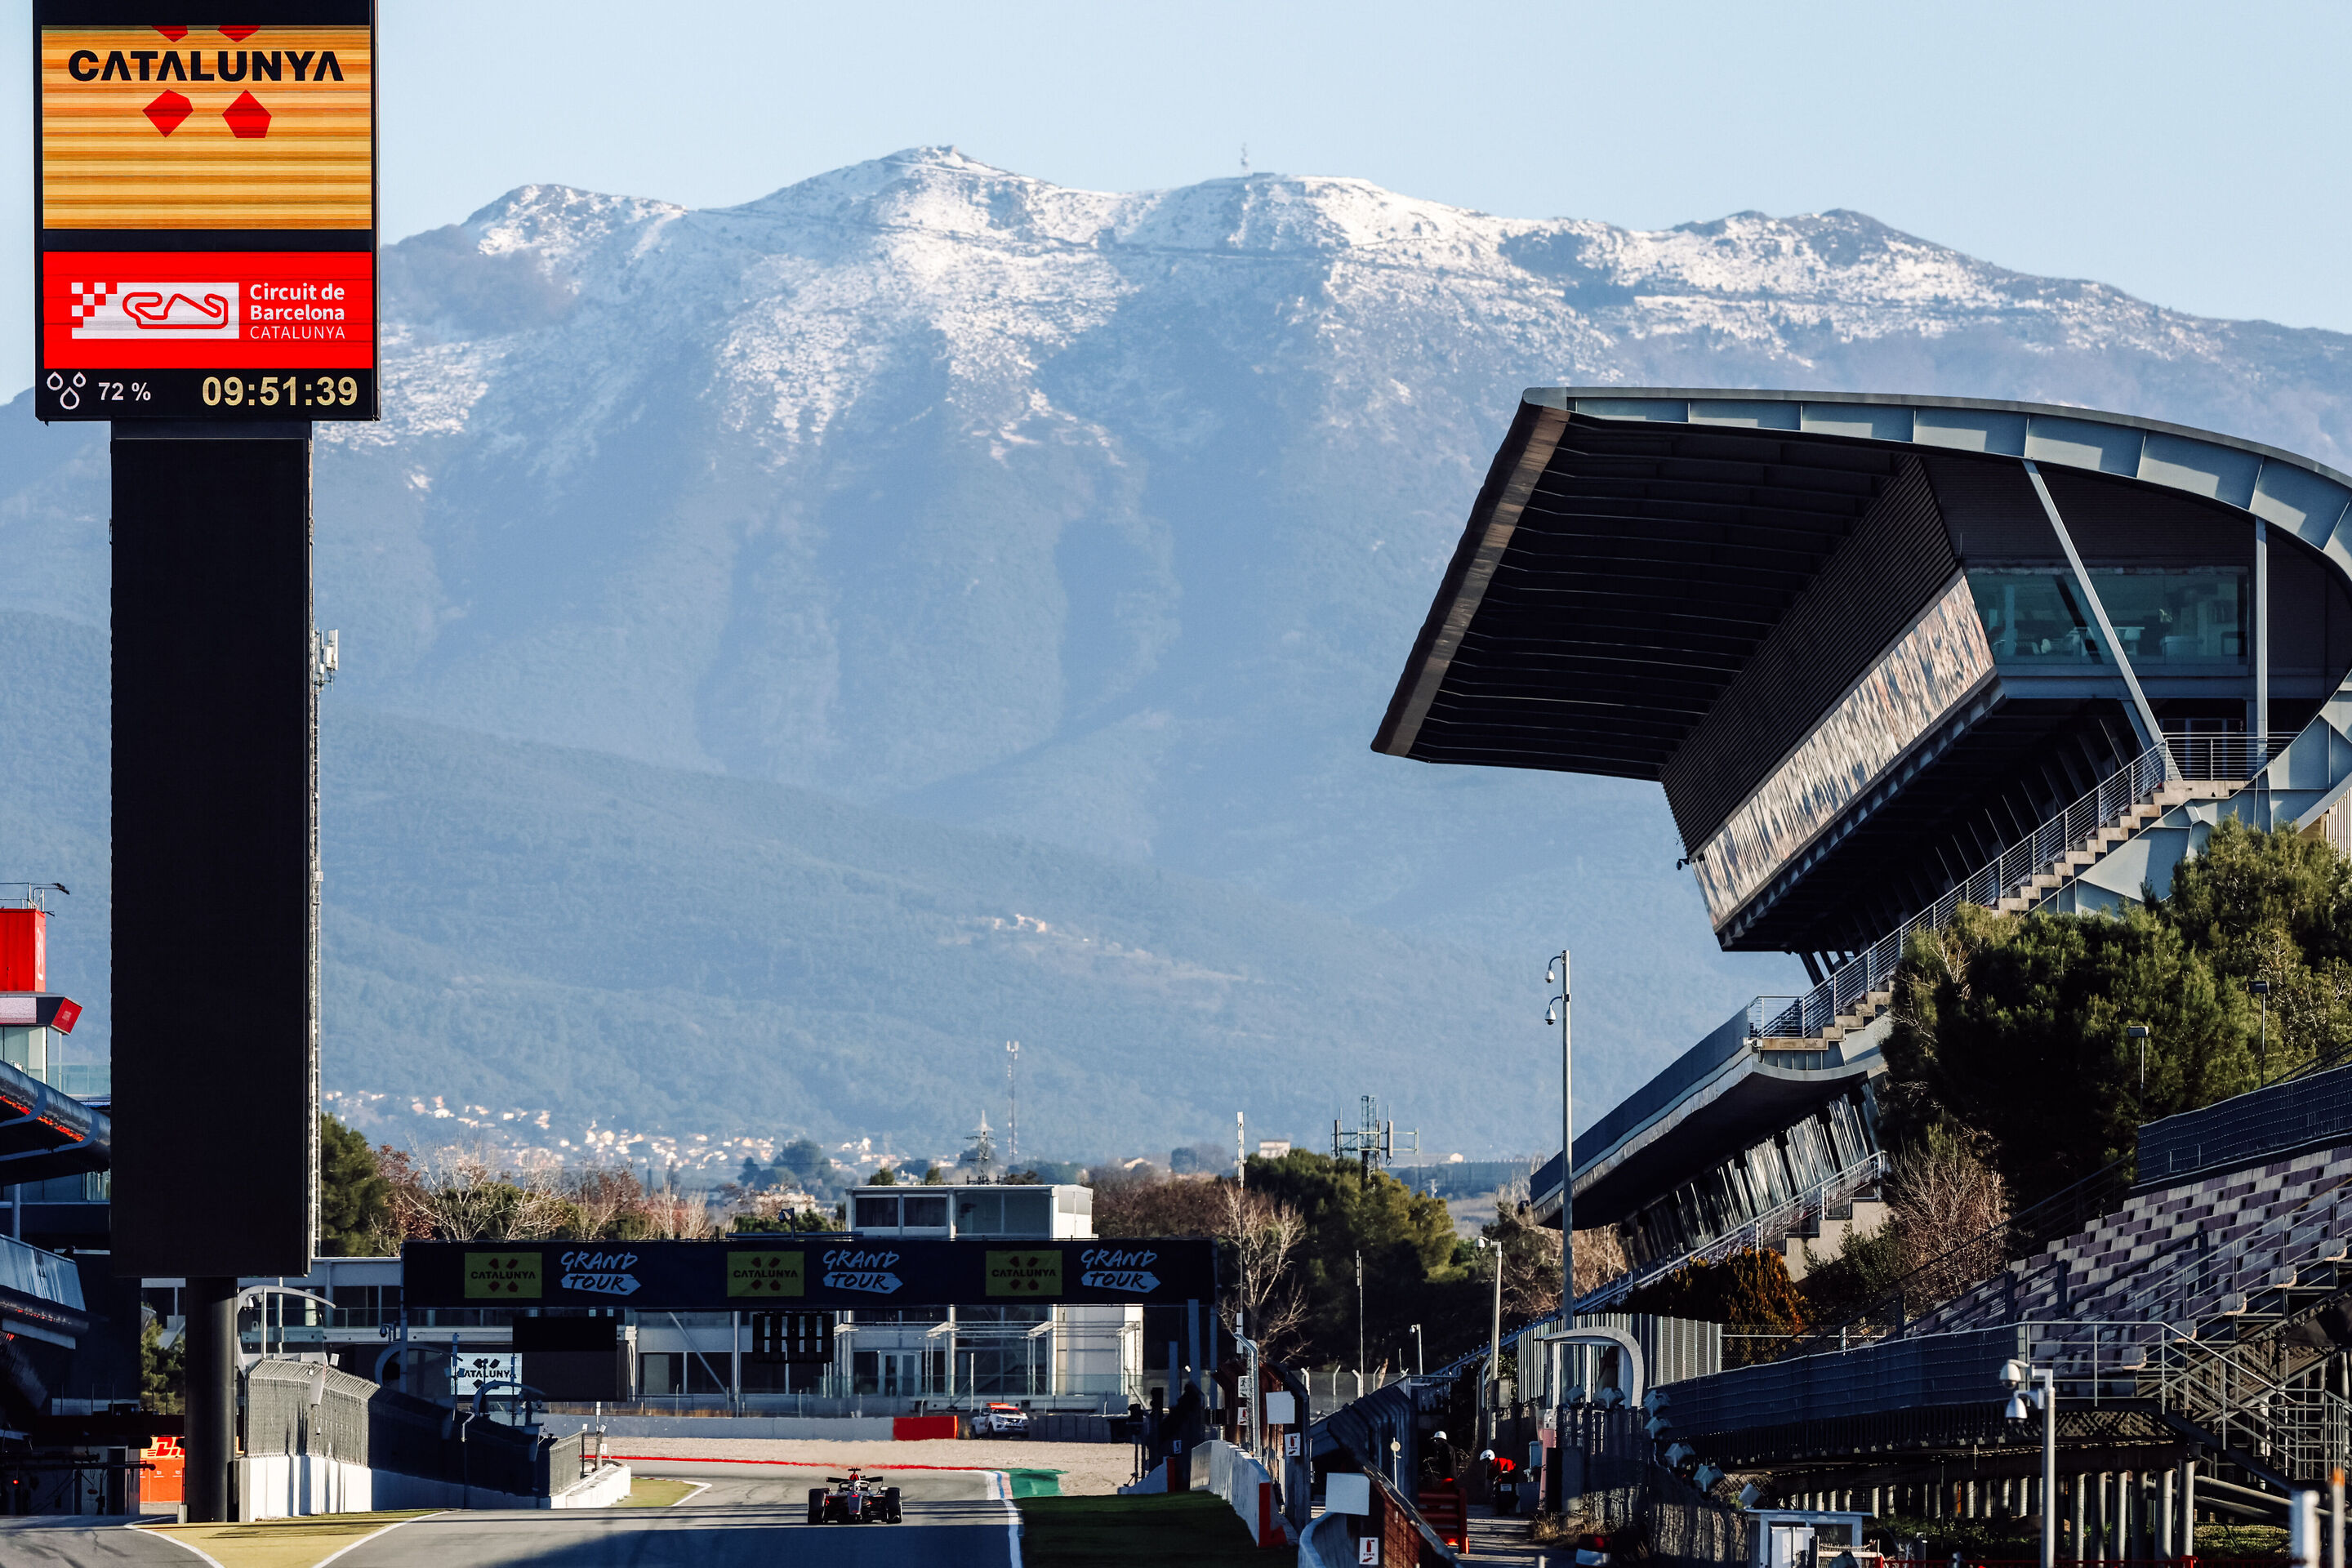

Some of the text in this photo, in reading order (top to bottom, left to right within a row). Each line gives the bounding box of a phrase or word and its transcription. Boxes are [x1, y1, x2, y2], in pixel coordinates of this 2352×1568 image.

[68, 49, 345, 82] CATALUNYA
[250, 283, 345, 301] Circuit de
[250, 304, 345, 321] Barcelona
[250, 326, 345, 340] CATALUNYA
[98, 382, 151, 401] 72 %
[202, 376, 358, 406] 09:51:39
[559, 1250, 639, 1272] GRAND
[822, 1249, 900, 1269] GRAND
[1080, 1248, 1158, 1268] GRAND
[470, 1271, 536, 1280] CATALUNYA
[733, 1269, 798, 1278] CATALUNYA
[831, 1272, 891, 1291] TOUR
[991, 1268, 1057, 1278] CATALUNYA
[1089, 1271, 1149, 1290] TOUR
[569, 1273, 629, 1293] TOUR
